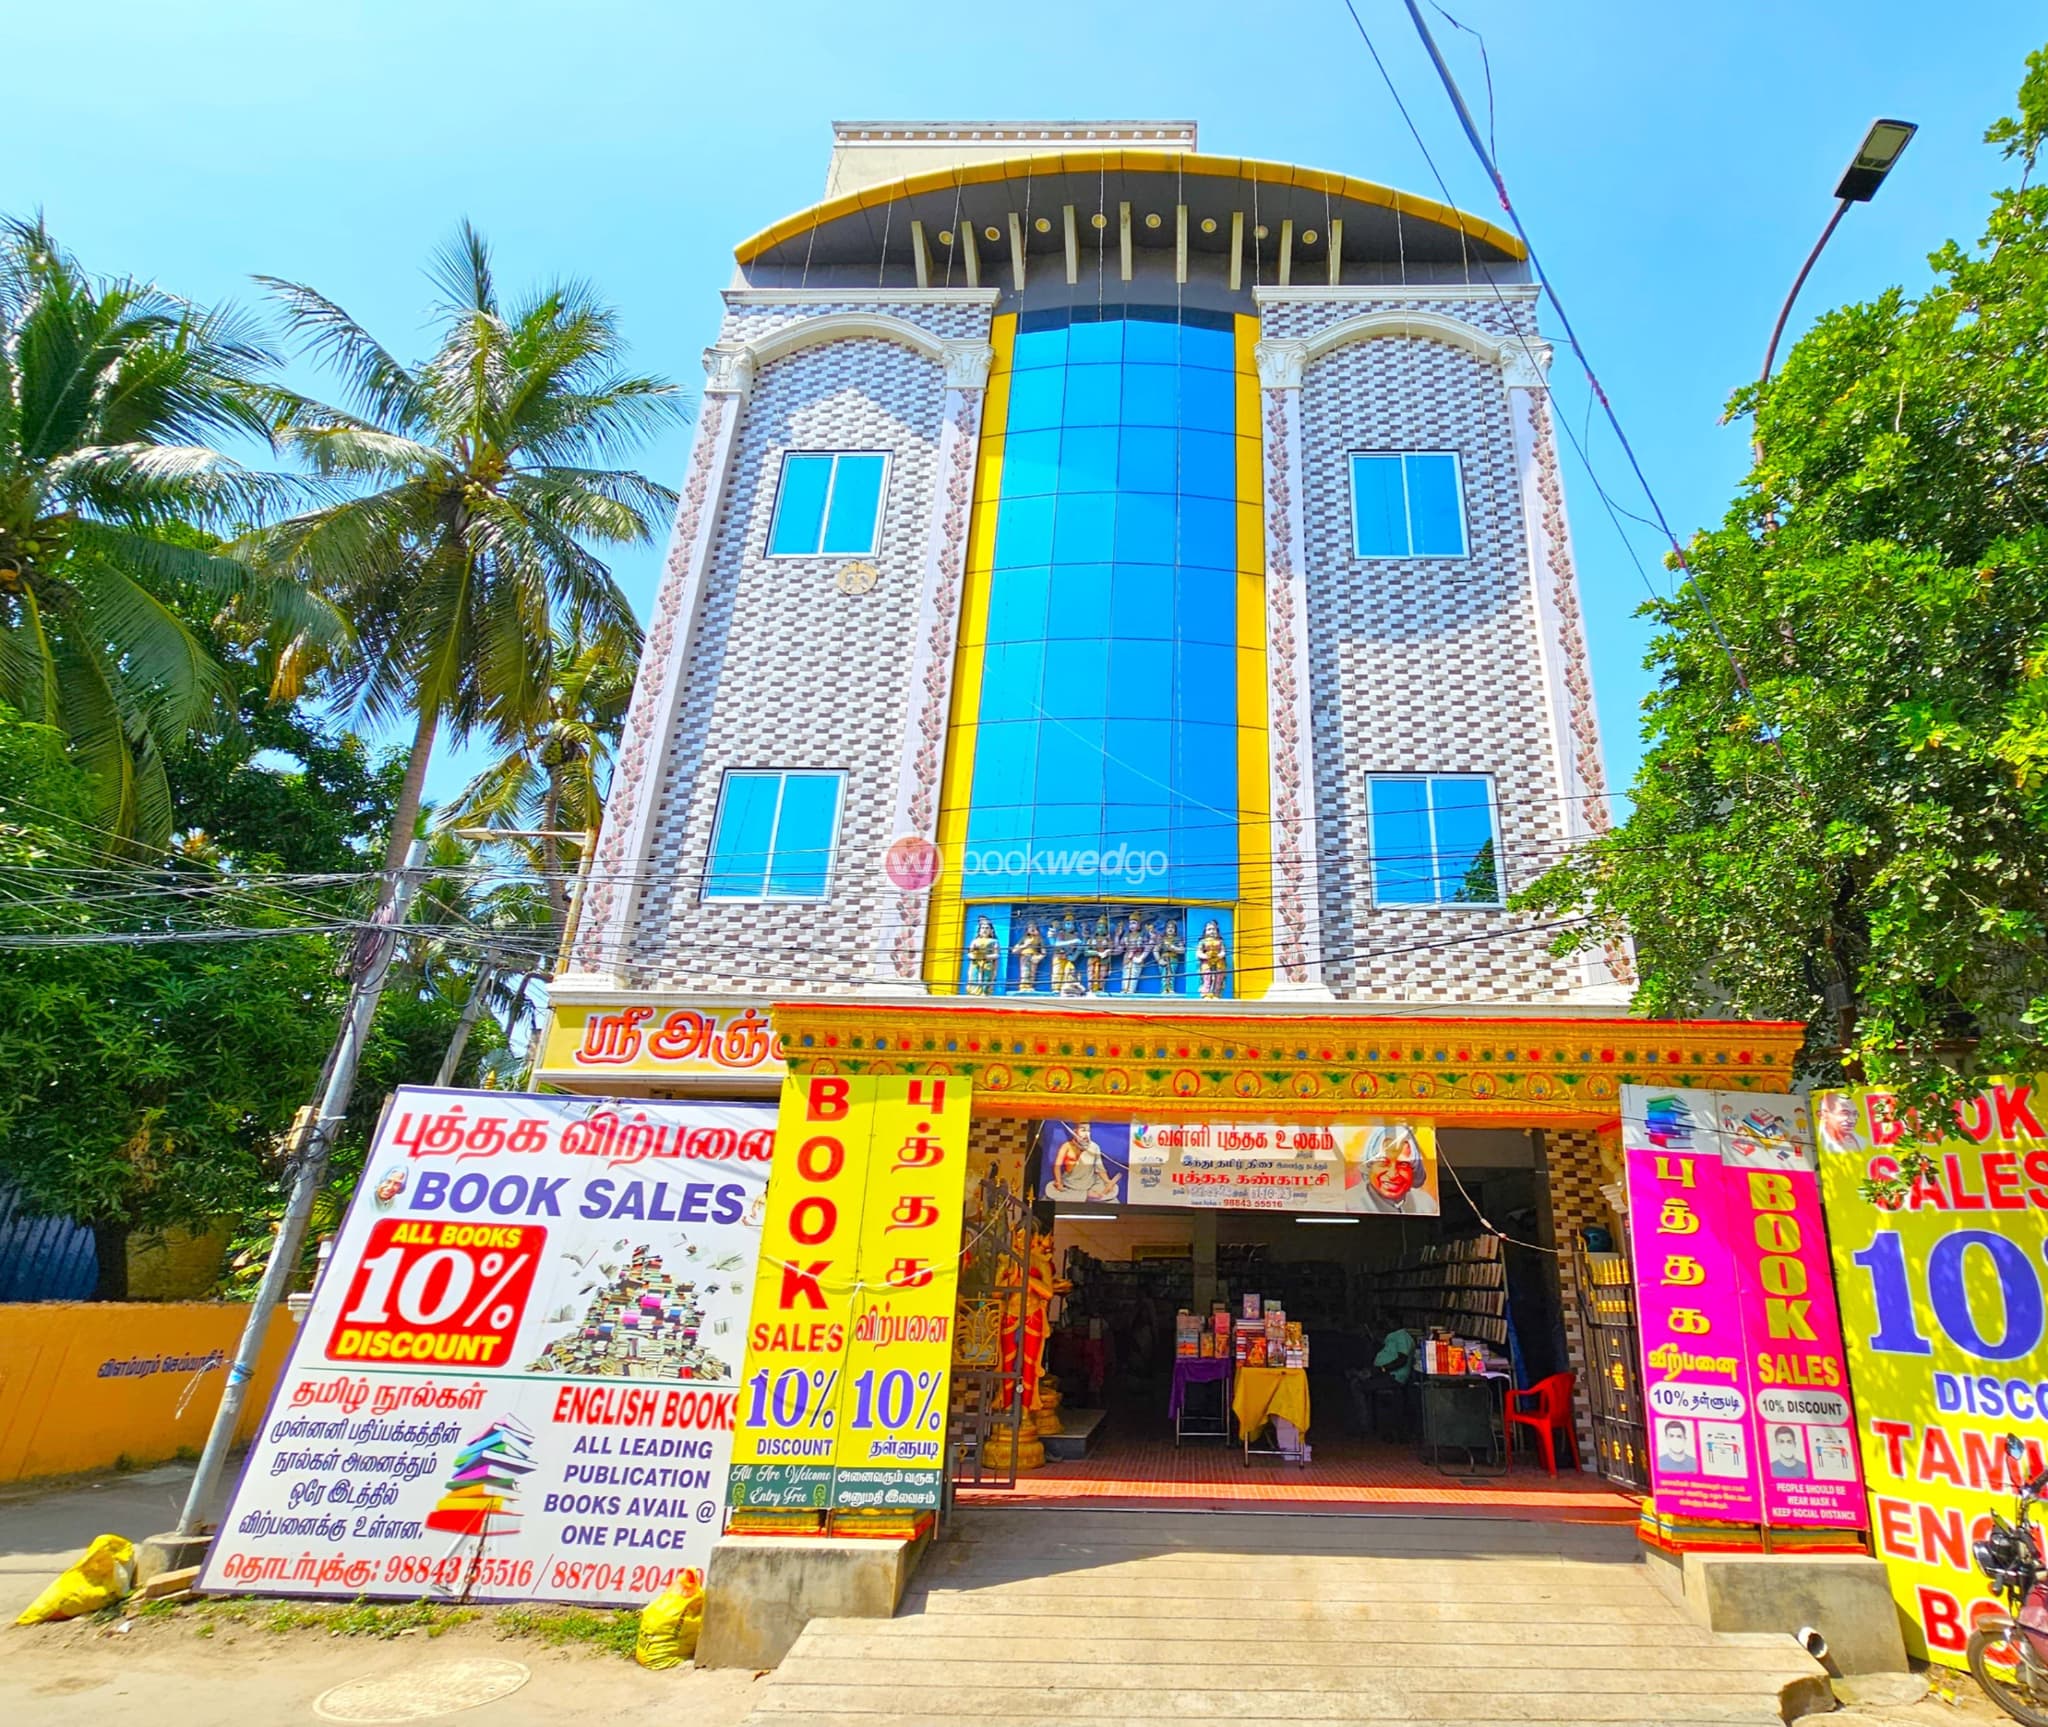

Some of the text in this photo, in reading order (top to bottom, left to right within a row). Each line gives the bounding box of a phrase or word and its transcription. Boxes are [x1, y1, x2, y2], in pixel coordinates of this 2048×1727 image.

[1865, 1085, 2048, 1146] BOK
[393, 1104, 777, 1168] புத்தக விற்பனை
[1157, 1121, 1334, 1151] வள்ளி புத்தக உலகம்
[779, 1077, 850, 1310] BOOK
[1172, 1170, 1330, 1187] புத்தக கண்காட்சி
[409, 1171, 746, 1225] BOOK SALES
[1223, 1199, 1251, 1207] 98843
[1254, 1200, 1283, 1208] 55516
[391, 1223, 521, 1249] ALL BOOKS
[1747, 1172, 1819, 1341] BOOK
[344, 1247, 530, 1329] 10%
[1853, 1229, 2048, 1362] 10
[752, 1322, 844, 1353] SALES
[856, 1301, 949, 1352] விற்பனை
[337, 1328, 501, 1361] DISCOUNT
[1757, 1352, 1841, 1386] SALES
[288, 1377, 488, 1415] தமிழ் நூல்கள்
[552, 1386, 660, 1427] ENGLISH
[745, 1368, 838, 1429] 10%
[851, 1368, 943, 1430] 10%
[1654, 1389, 1689, 1407] 10%
[1762, 1399, 1843, 1416] 10% DISCOUNT
[573, 1436, 713, 1459] ALL LEADING
[757, 1438, 833, 1456] DISCOUNT
[869, 1435, 939, 1459] தள்ளுபடி
[341, 1450, 438, 1481] அனைத்தும்
[563, 1465, 710, 1489] PUBLICATION
[785, 1465, 832, 1484] Welcome
[288, 1479, 399, 1509] ஒரே இடத்தில்
[544, 1494, 716, 1523] BOOKS AVAIL @
[750, 1487, 807, 1506] Entry Free
[238, 1510, 347, 1541] விற்பனைக்கு
[1793, 1508, 1819, 1519] SOCIAL
[1820, 1509, 1856, 1520] DISTANCE
[561, 1525, 687, 1549] ONE PLACE
[384, 1556, 461, 1584] 98843
[551, 1561, 624, 1592] 88704
[629, 1563, 704, 1592] 204
